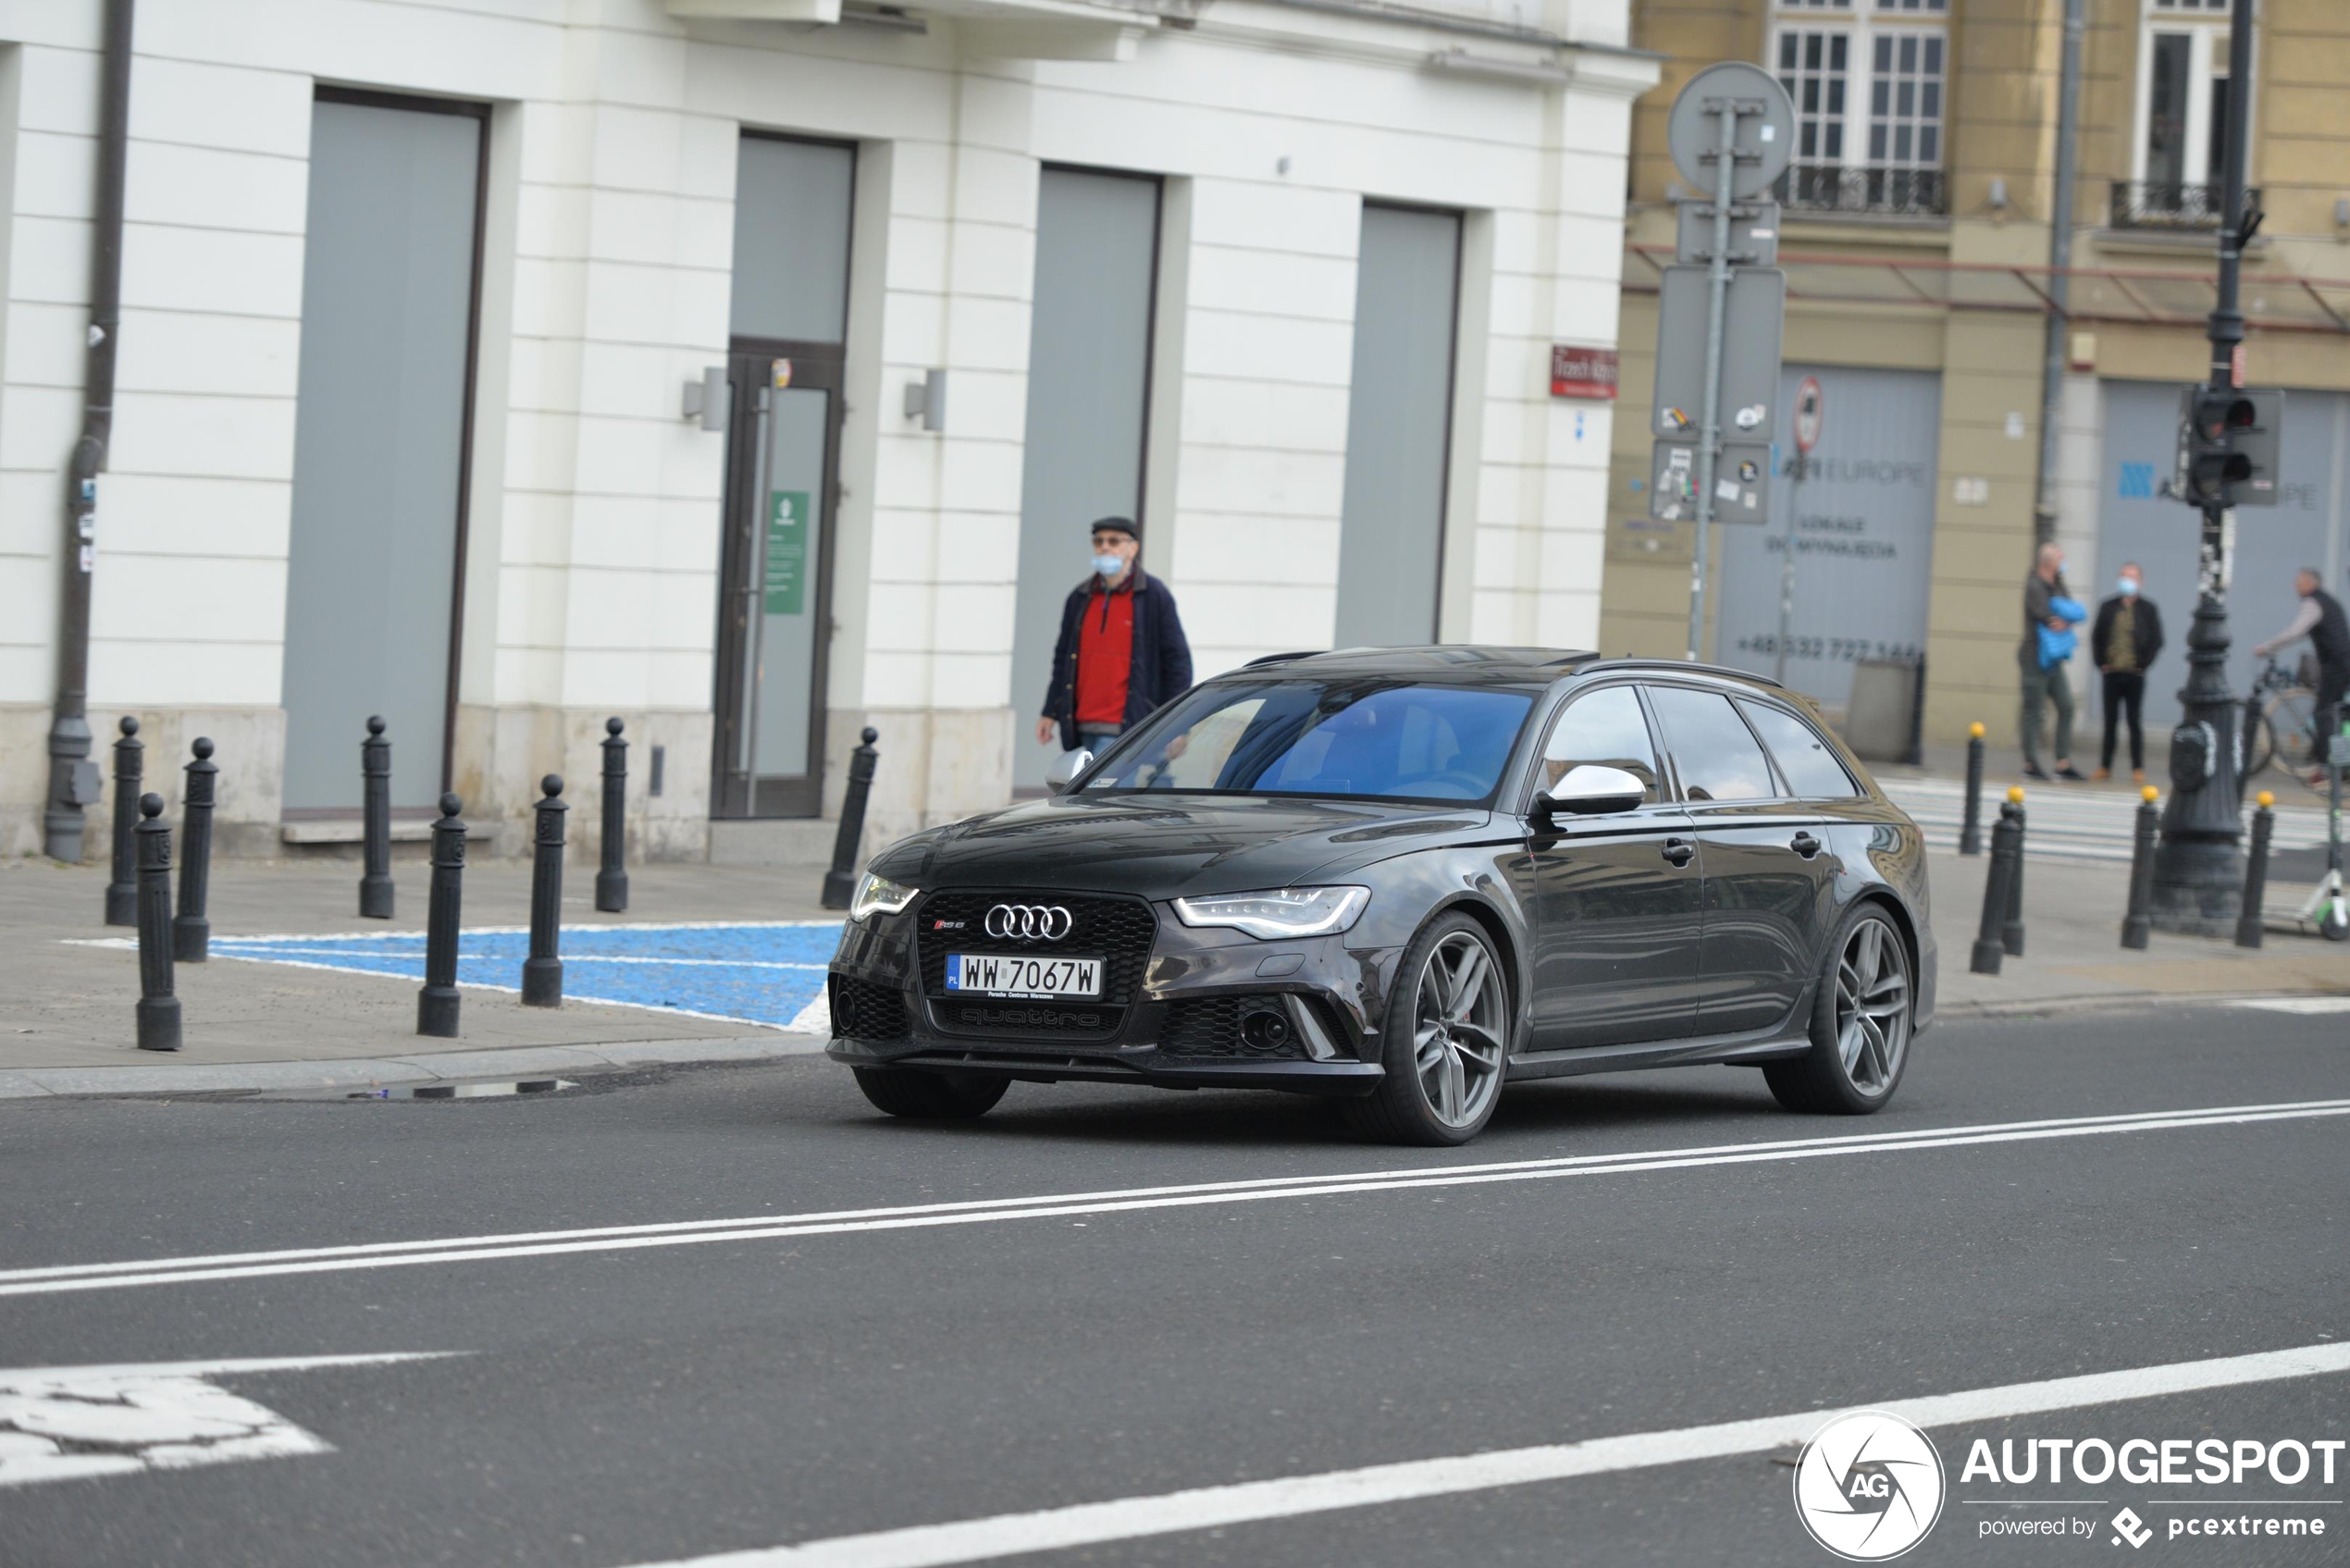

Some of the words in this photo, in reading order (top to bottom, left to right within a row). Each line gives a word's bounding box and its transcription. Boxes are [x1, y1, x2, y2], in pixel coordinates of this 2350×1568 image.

[948, 976, 958, 984] PL
[966, 957, 998, 989] WW
[1008, 959, 1094, 992] 7067W
[961, 1007, 1100, 1027] quattro
